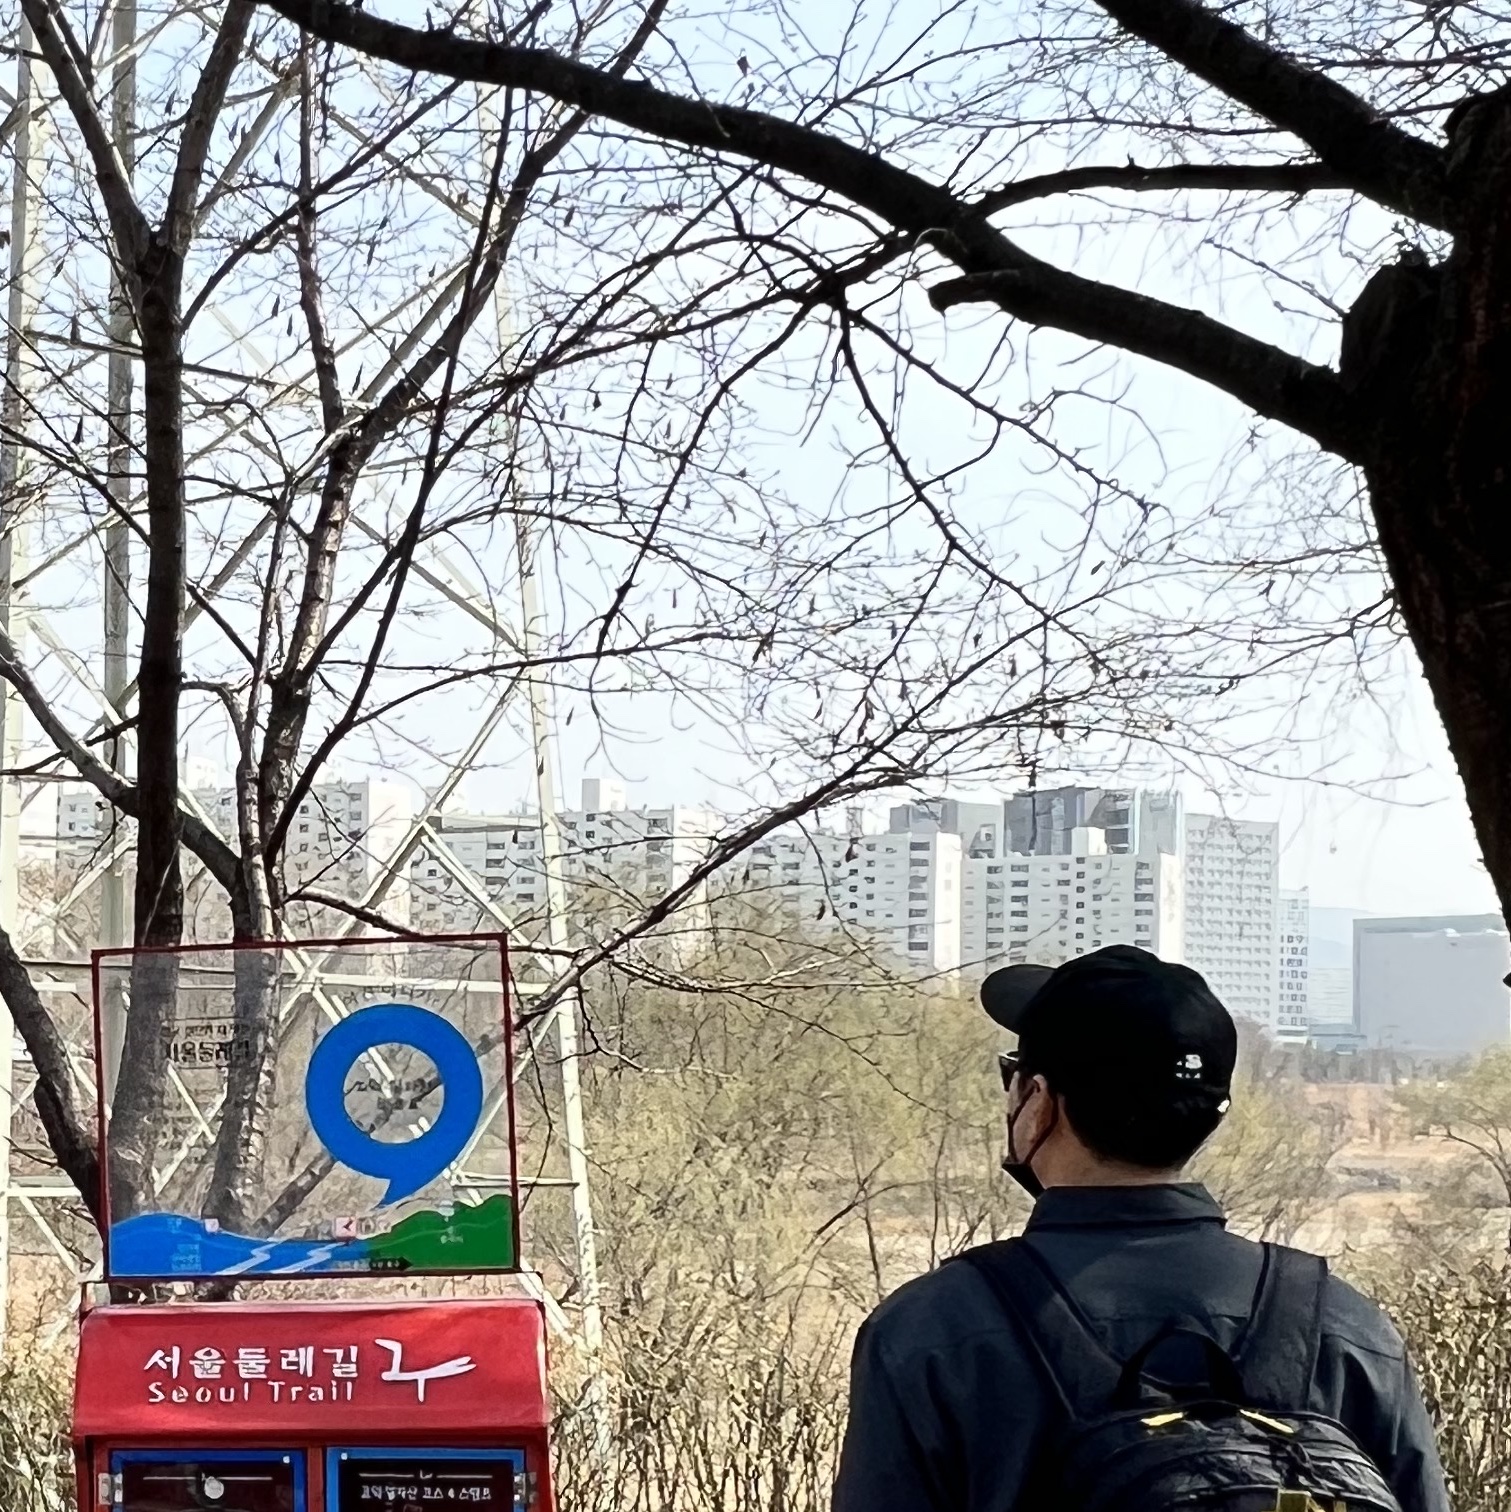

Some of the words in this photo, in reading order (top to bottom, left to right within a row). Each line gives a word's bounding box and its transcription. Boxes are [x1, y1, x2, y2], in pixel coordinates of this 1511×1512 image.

[143, 1345, 360, 1380] 서울둘레길
[148, 1380, 250, 1404] Seoul
[267, 1379, 355, 1403] Trail
